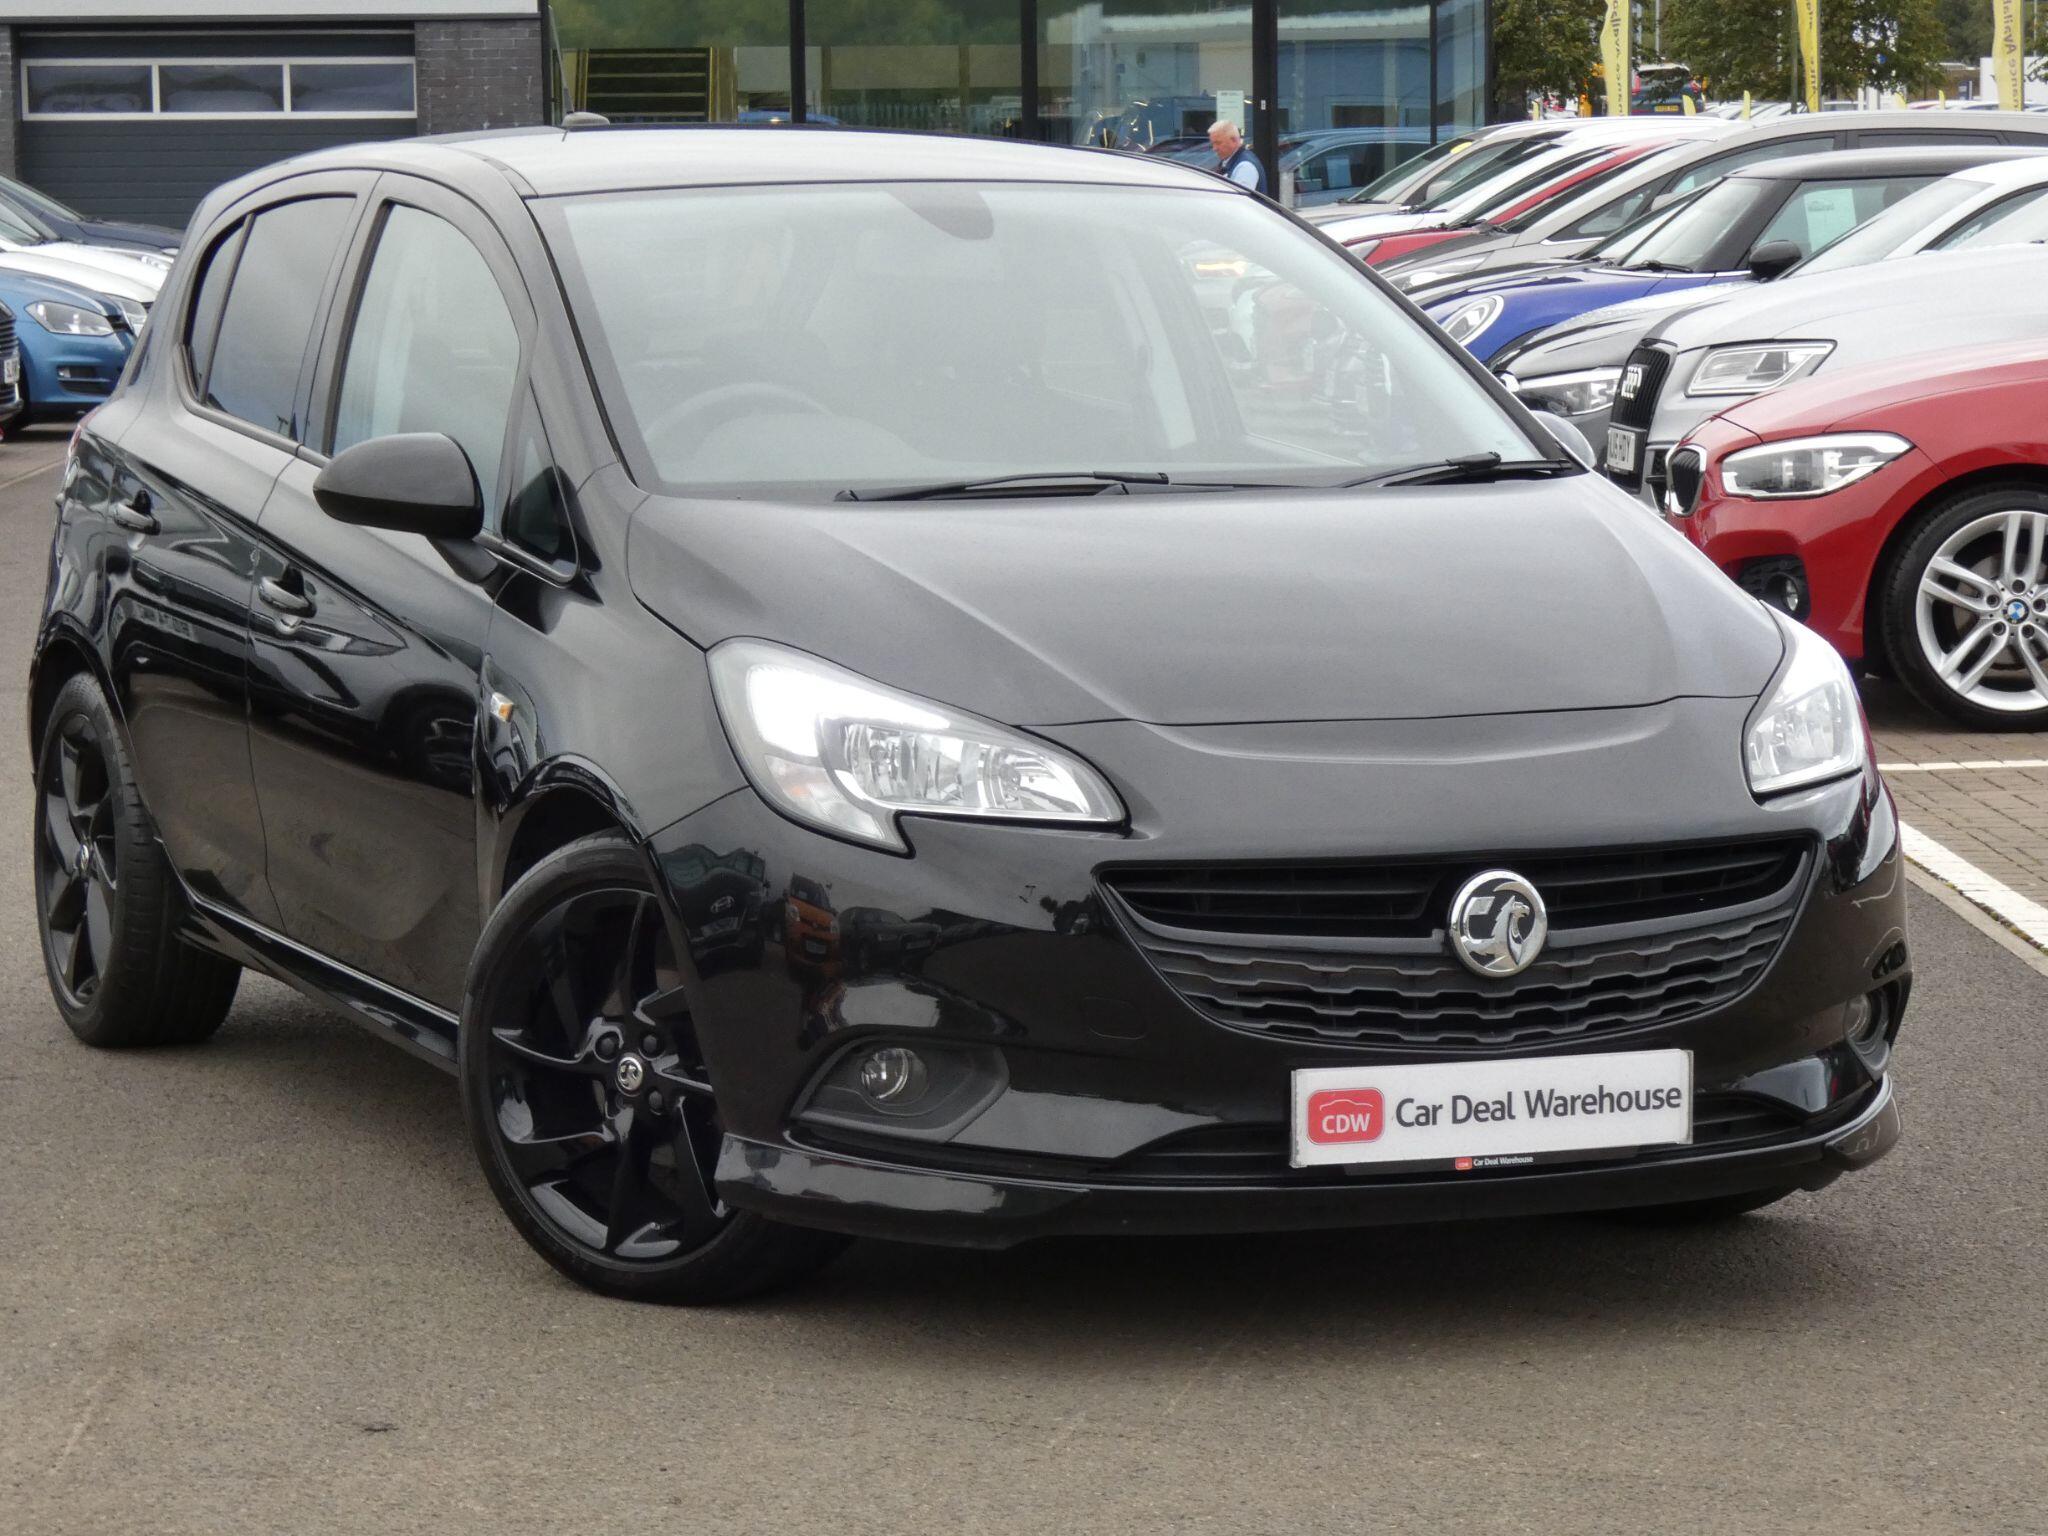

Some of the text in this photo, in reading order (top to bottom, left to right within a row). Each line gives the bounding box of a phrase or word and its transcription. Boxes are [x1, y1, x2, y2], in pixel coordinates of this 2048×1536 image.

[1395, 1084, 1682, 1128] Car Deal Warehouse
[1321, 1113, 1371, 1134] CDW
[1473, 1158, 1484, 1167] Car
[1484, 1157, 1499, 1166] Deal
[1499, 1156, 1534, 1165] Warehouse
